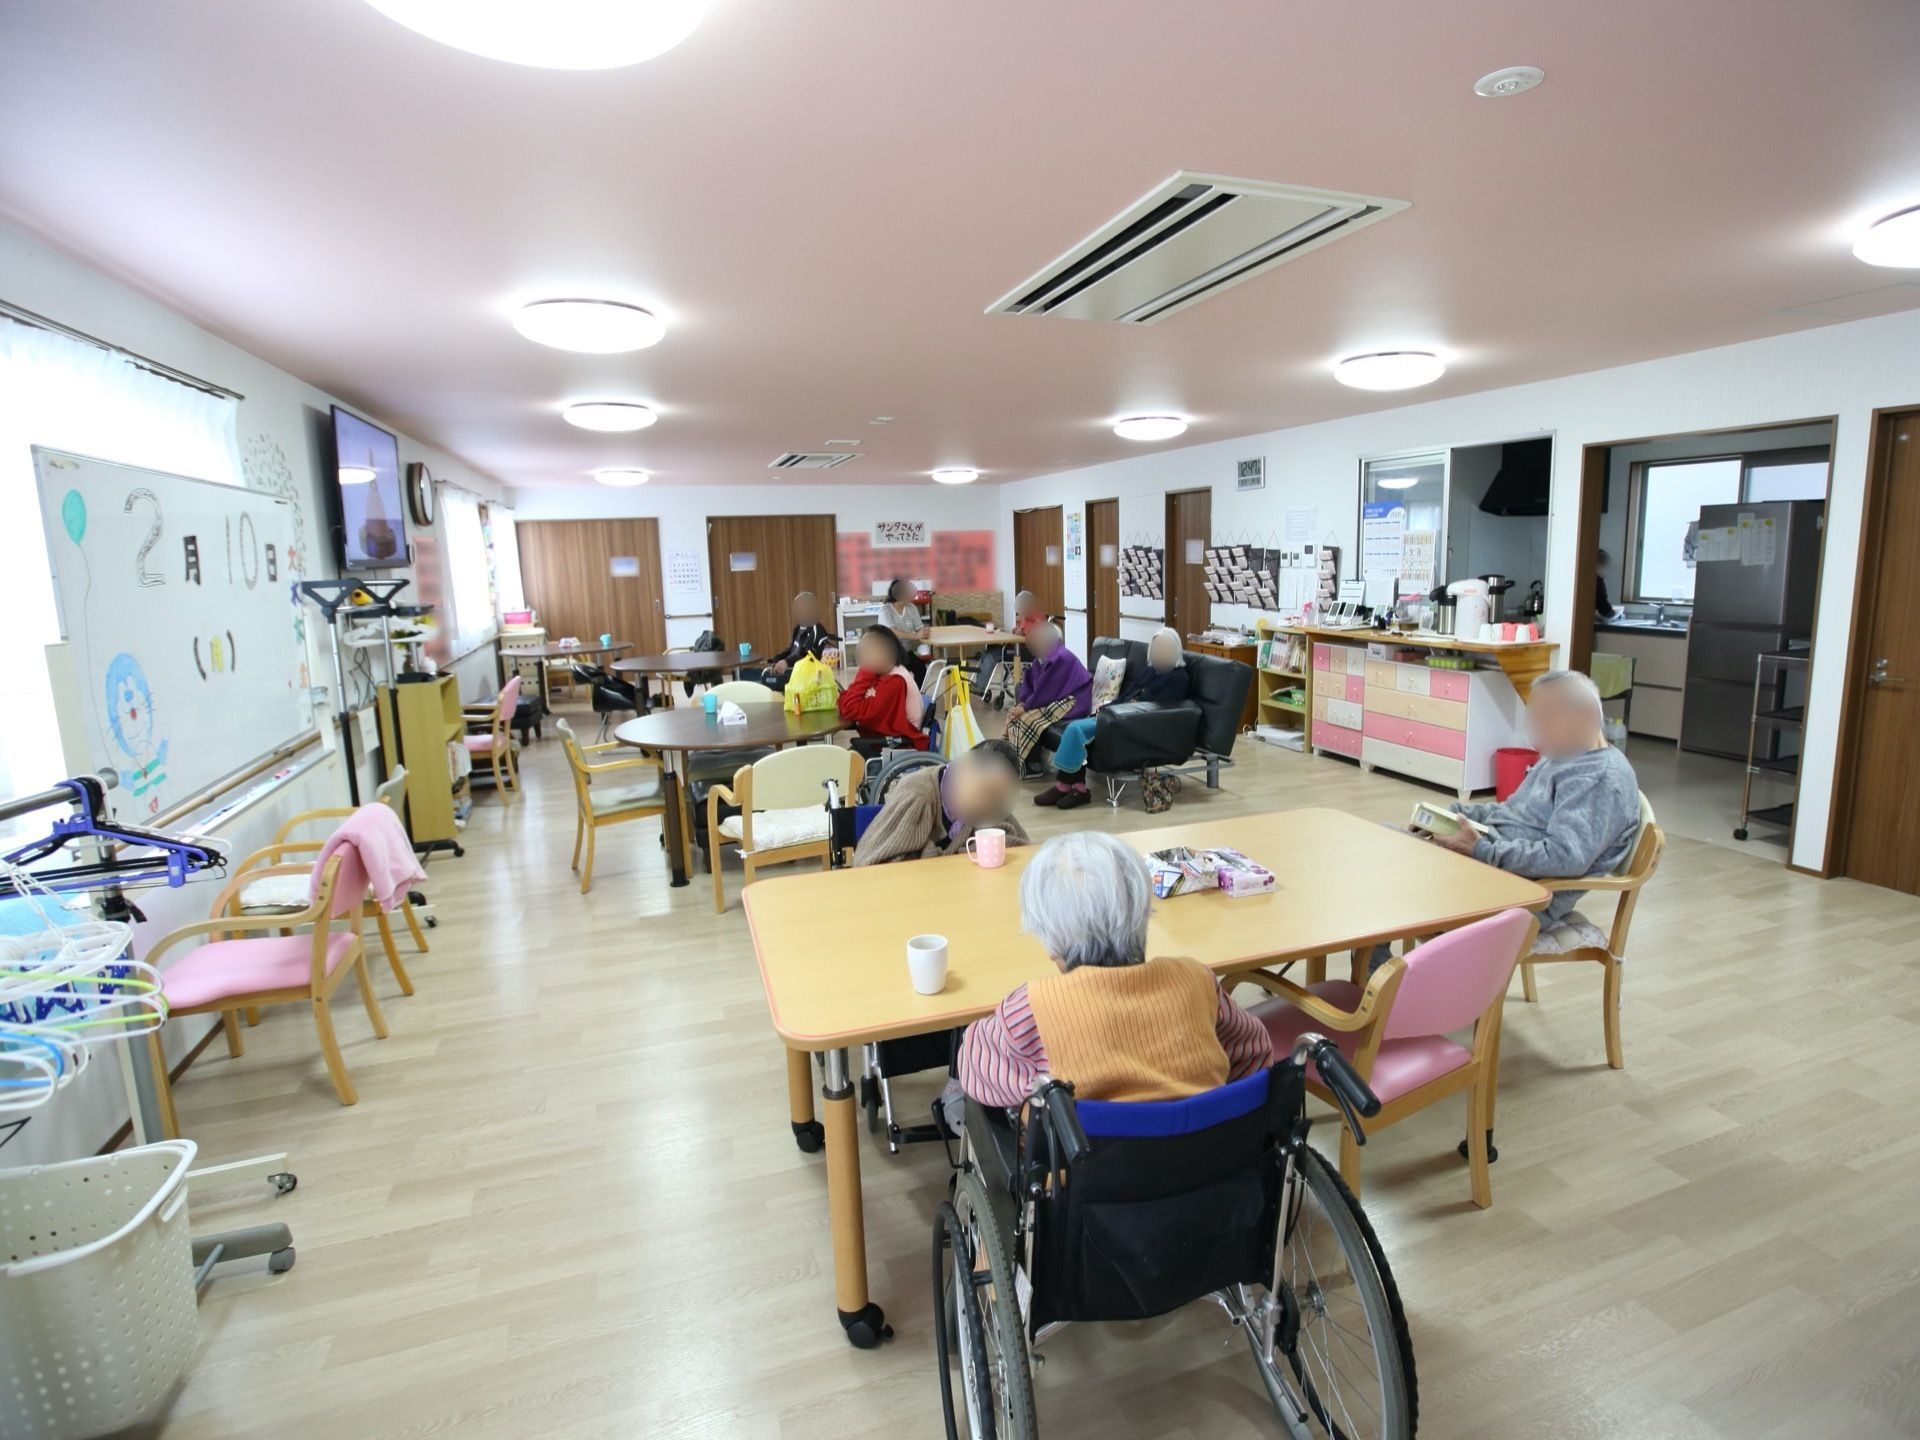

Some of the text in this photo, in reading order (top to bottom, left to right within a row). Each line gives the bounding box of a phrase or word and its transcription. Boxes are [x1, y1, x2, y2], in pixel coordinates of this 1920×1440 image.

[876, 521, 924, 533] サンタさんが
